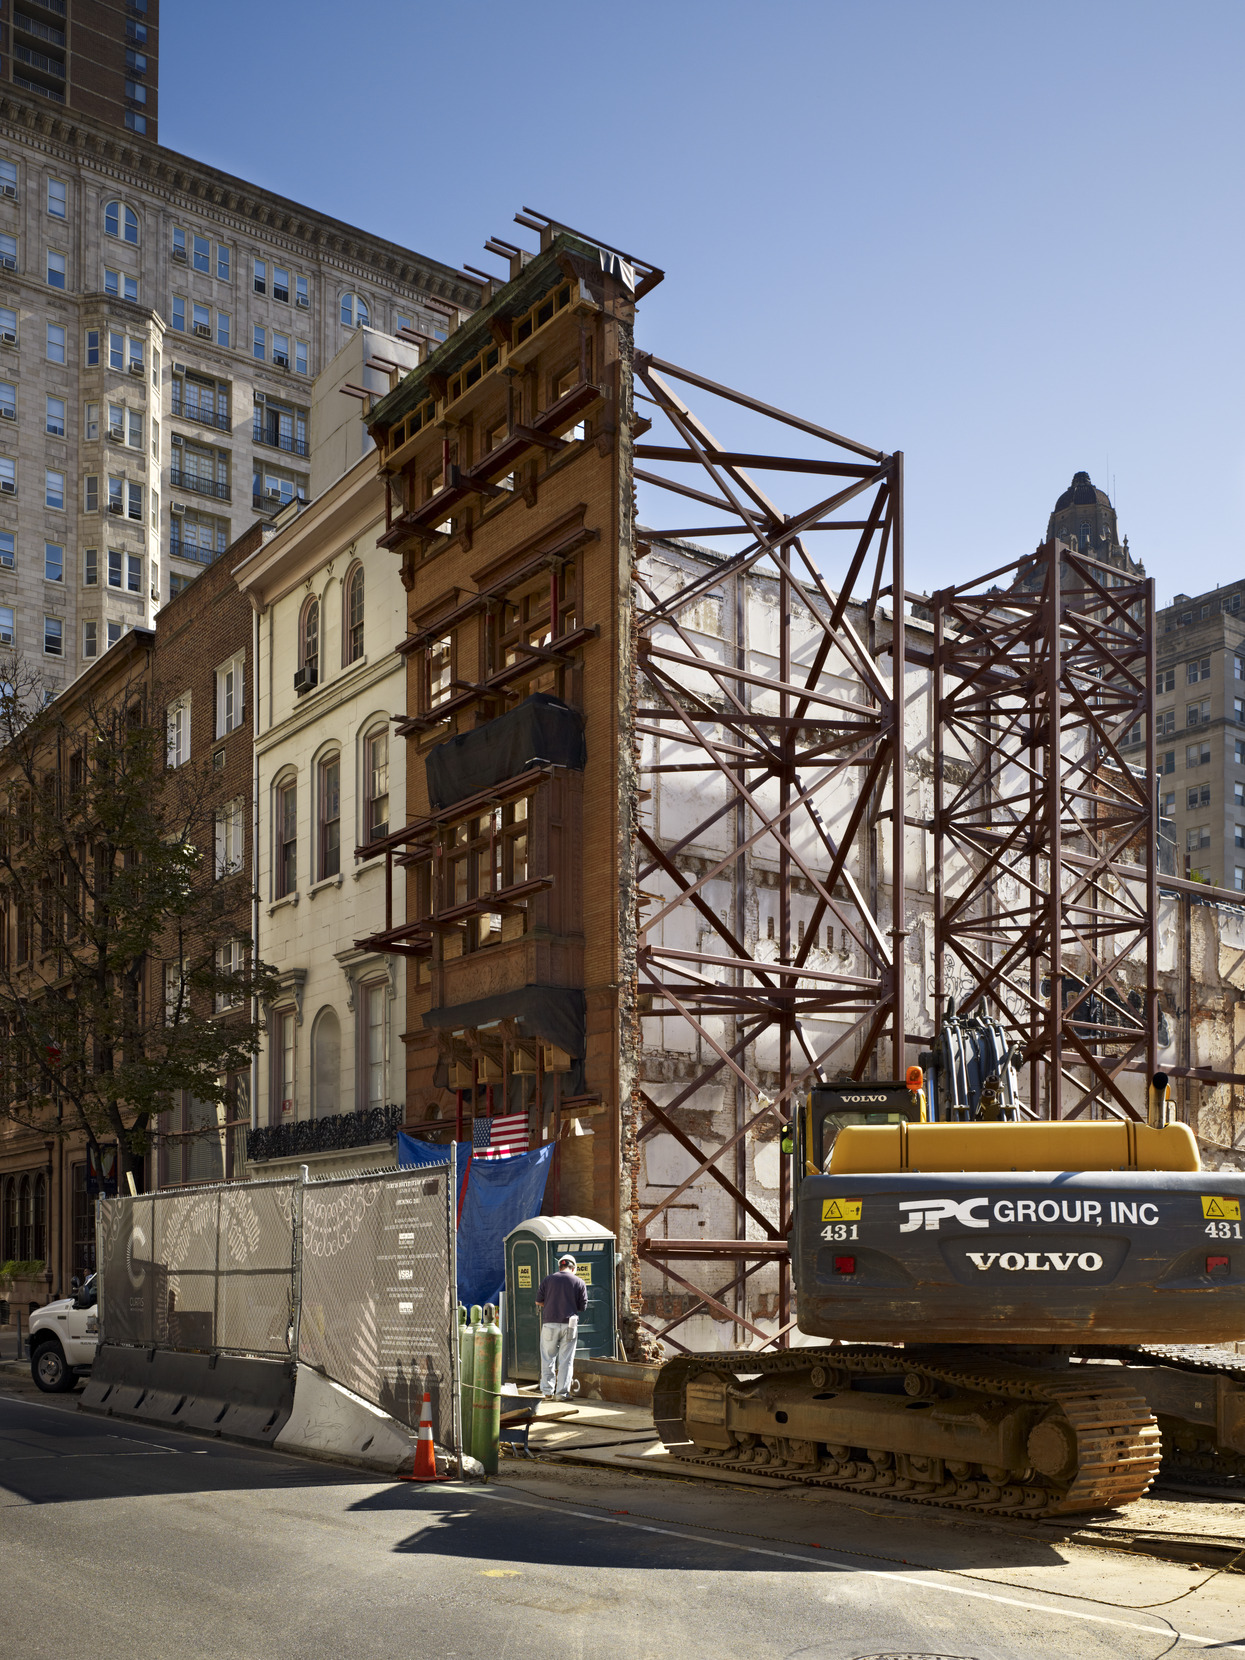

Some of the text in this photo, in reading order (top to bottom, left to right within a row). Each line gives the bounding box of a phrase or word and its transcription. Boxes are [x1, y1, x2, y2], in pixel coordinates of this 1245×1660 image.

[840, 1094, 888, 1103] VOLVO
[899, 1197, 1160, 1233] JPC GROUP, INC
[820, 1224, 860, 1241] 431
[1204, 1221, 1244, 1239] 431
[965, 1252, 1103, 1271] VOLVO
